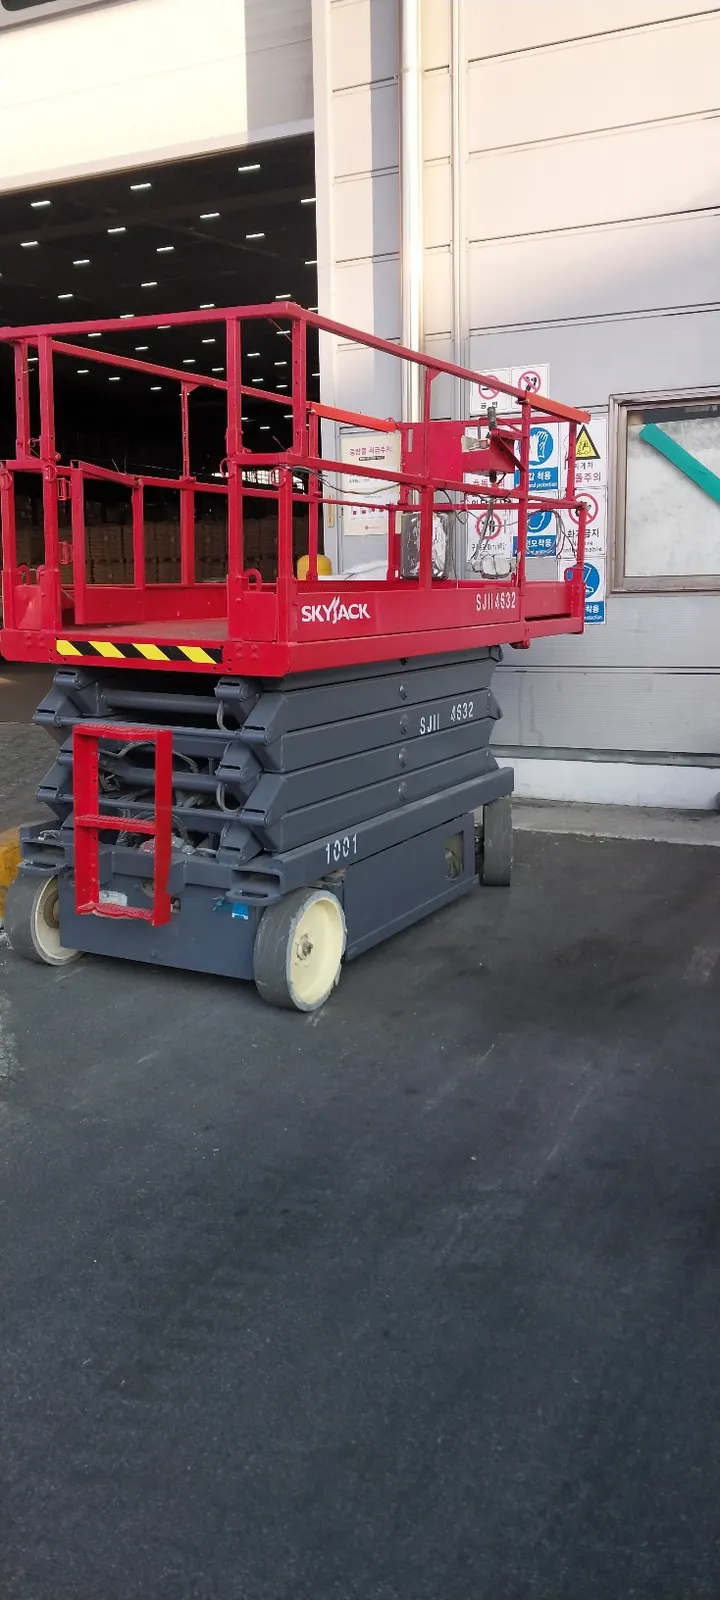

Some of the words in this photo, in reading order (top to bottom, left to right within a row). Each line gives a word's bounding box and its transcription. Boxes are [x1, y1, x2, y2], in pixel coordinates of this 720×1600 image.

[575, 472, 601, 483] 돌주의
[301, 596, 371, 624] SKYJACK
[450, 701, 474, 722] 4632
[325, 833, 357, 865] 1001
